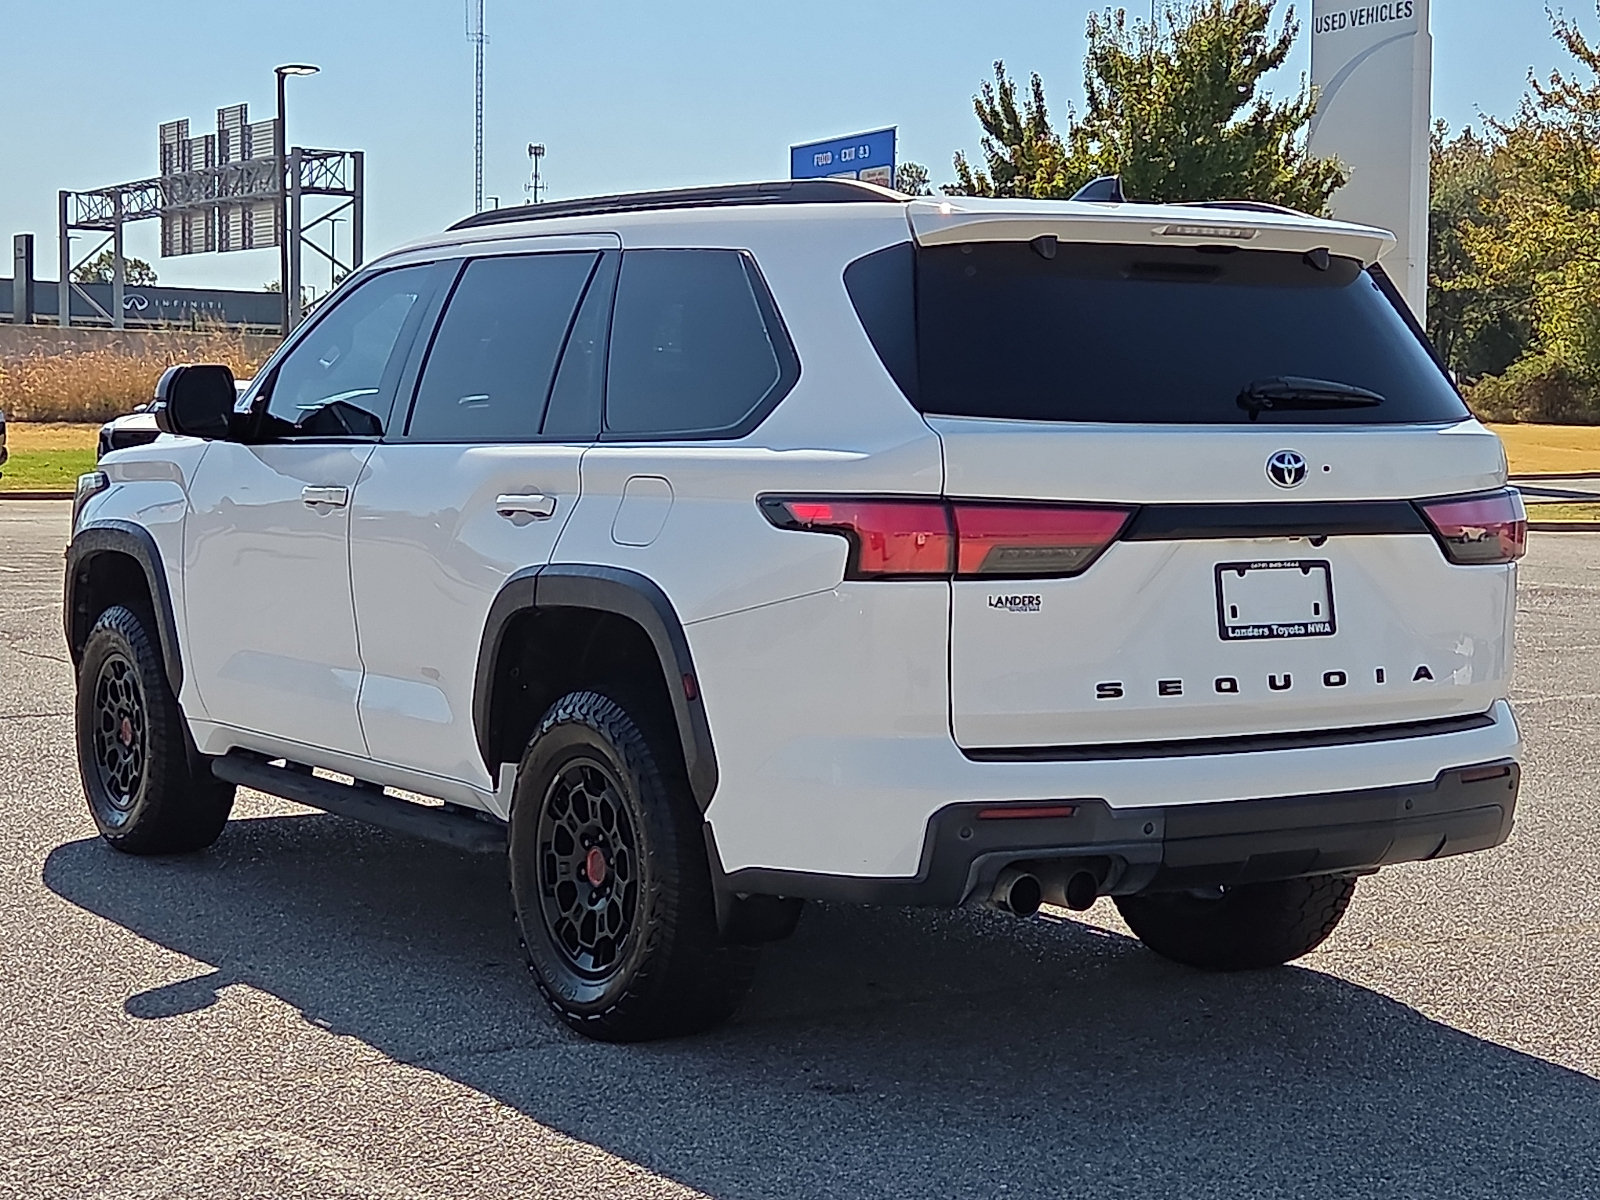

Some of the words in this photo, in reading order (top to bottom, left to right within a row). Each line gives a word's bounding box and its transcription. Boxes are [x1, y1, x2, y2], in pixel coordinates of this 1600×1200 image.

[1315, 12, 1346, 34] USED
[1350, 1, 1413, 26] VEHICLES
[155, 300, 222, 309] INFINITI
[988, 595, 1041, 607] LANDERS
[1228, 625, 1269, 637] Landers
[1271, 624, 1305, 637] Toyota
[1307, 623, 1331, 633] NWA
[1096, 665, 1434, 699] SEQUOIA
